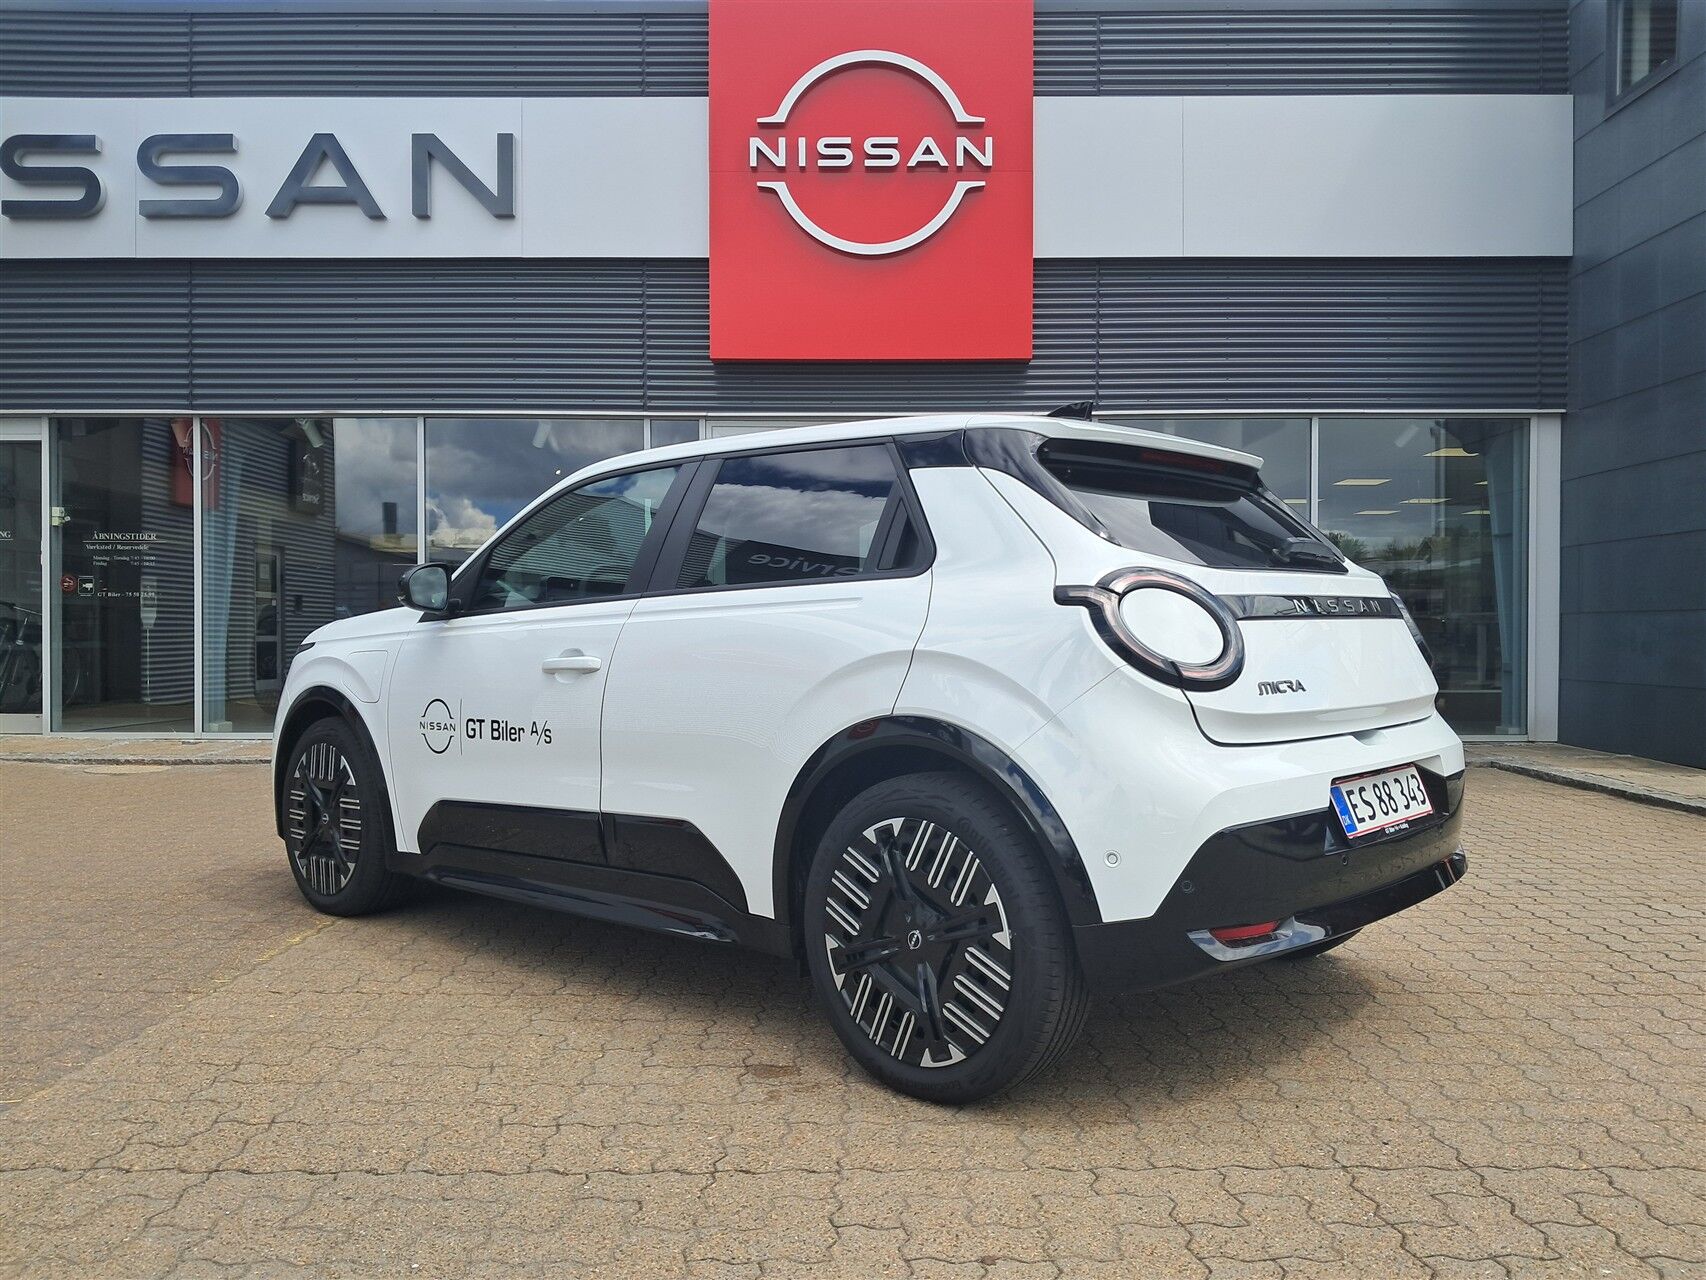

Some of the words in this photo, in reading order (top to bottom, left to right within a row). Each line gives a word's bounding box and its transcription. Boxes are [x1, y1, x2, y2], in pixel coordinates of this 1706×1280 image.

[749, 136, 993, 168] NISSAN
[0, 132, 516, 221] SSAN
[92, 531, 157, 540] ÅBNINGSTIDER
[1292, 599, 1381, 613] NISSAN
[1257, 679, 1307, 696] MICRA
[419, 721, 456, 732] NISSAN
[465, 718, 485, 740] GT
[490, 719, 525, 742] Biler
[1345, 786, 1376, 824] ES
[1372, 781, 1398, 816] 88
[1393, 774, 1426, 810] 343
